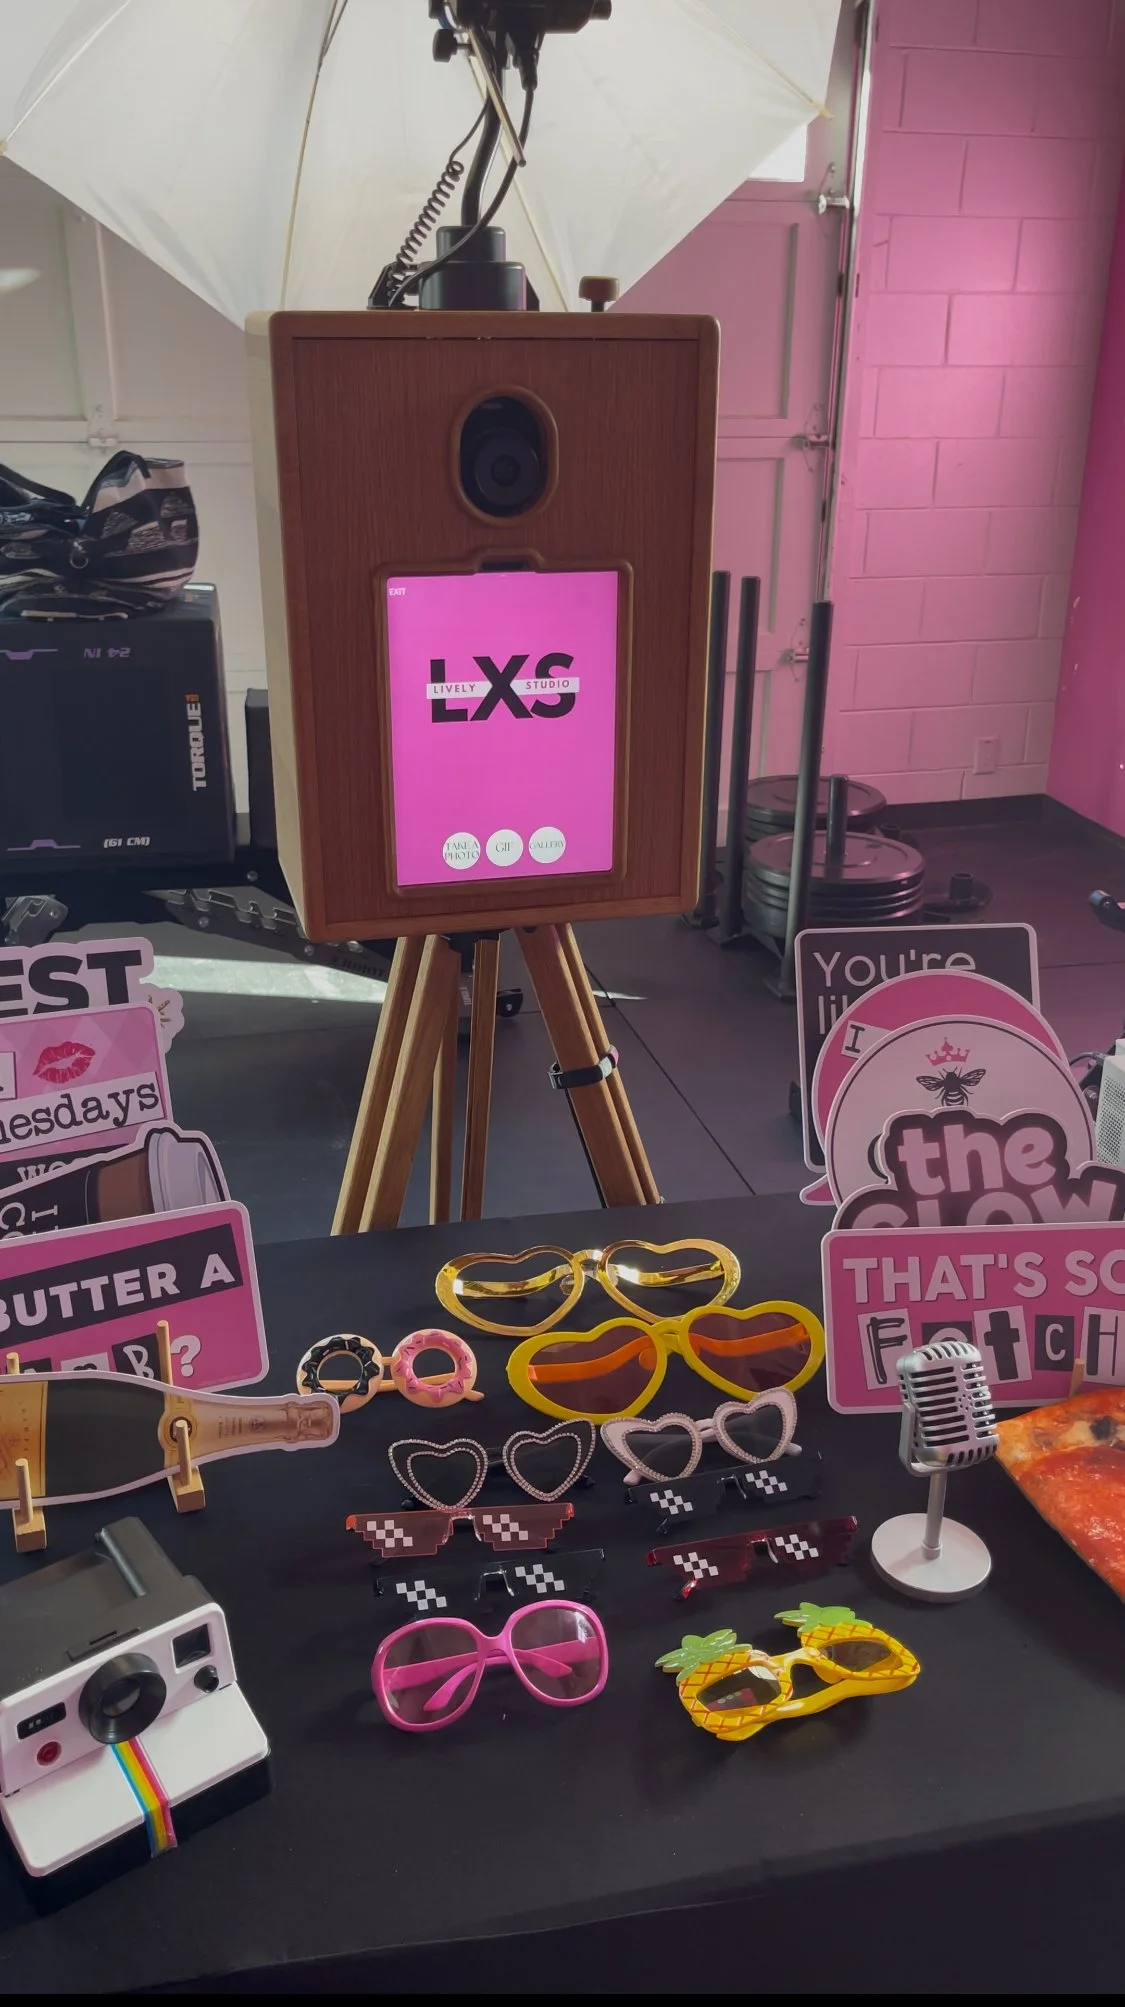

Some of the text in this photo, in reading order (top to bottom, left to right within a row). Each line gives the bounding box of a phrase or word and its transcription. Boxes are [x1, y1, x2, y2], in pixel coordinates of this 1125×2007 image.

[389, 587, 406, 596] EXIT
[430, 652, 576, 723] LXS
[433, 679, 570, 694] LIVELY STUDIO
[187, 703, 207, 791] TORQUE
[444, 852, 480, 861] PHOTO
[447, 842, 468, 851] TAKE
[495, 842, 514, 852] GIF
[529, 841, 564, 850] GALLERY
[845, 1024, 866, 1053] I
[898, 1124, 1056, 1195] the
[200, 1253, 235, 1289] A
[842, 1252, 1047, 1303] THAT'S
